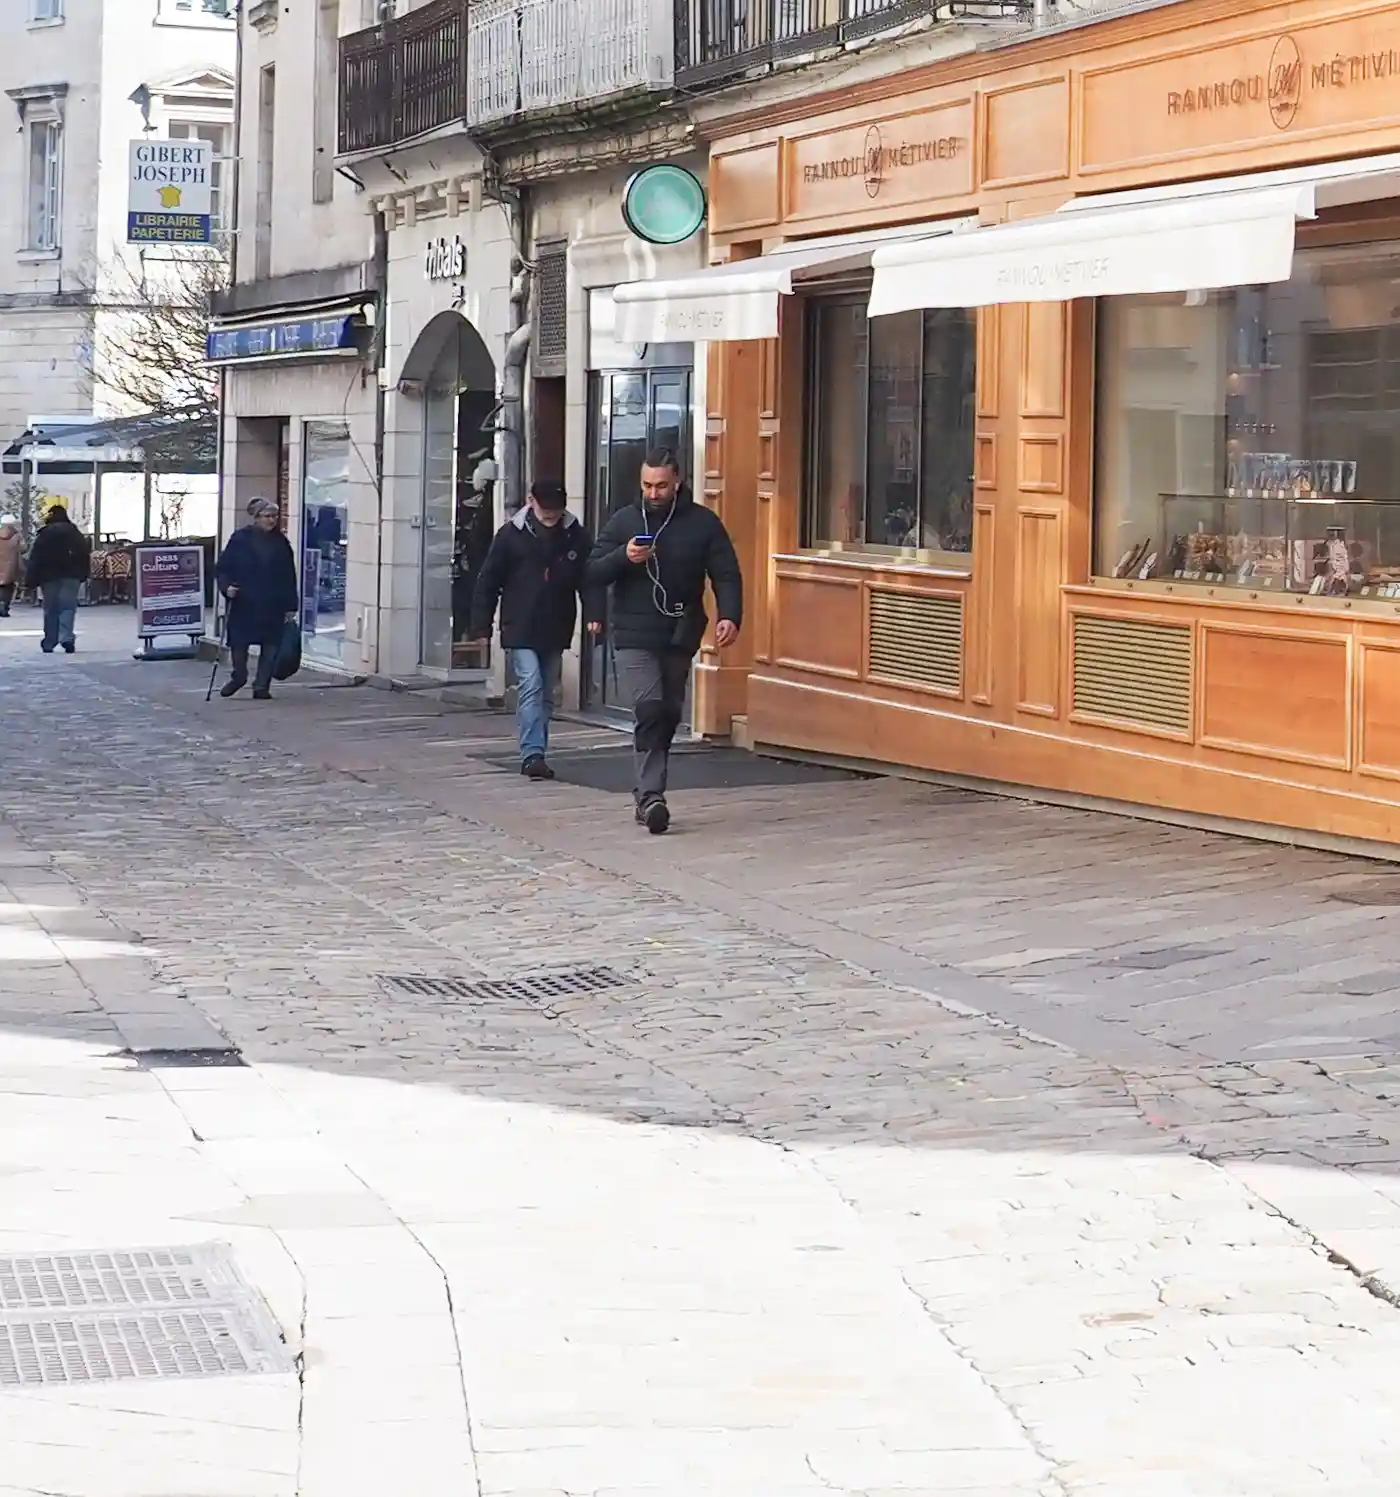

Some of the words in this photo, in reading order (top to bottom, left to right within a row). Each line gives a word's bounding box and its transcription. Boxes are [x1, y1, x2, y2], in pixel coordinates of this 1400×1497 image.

[1167, 75, 1263, 116] RANNOU
[137, 145, 206, 164] GIBERT
[134, 165, 206, 184] JOSEPH
[804, 157, 860, 183] RANNOU
[136, 214, 202, 227] LIBRAIRIE
[131, 227, 205, 240] PAPETERIE
[155, 554, 179, 564] pass
[142, 563, 180, 572] Culture
